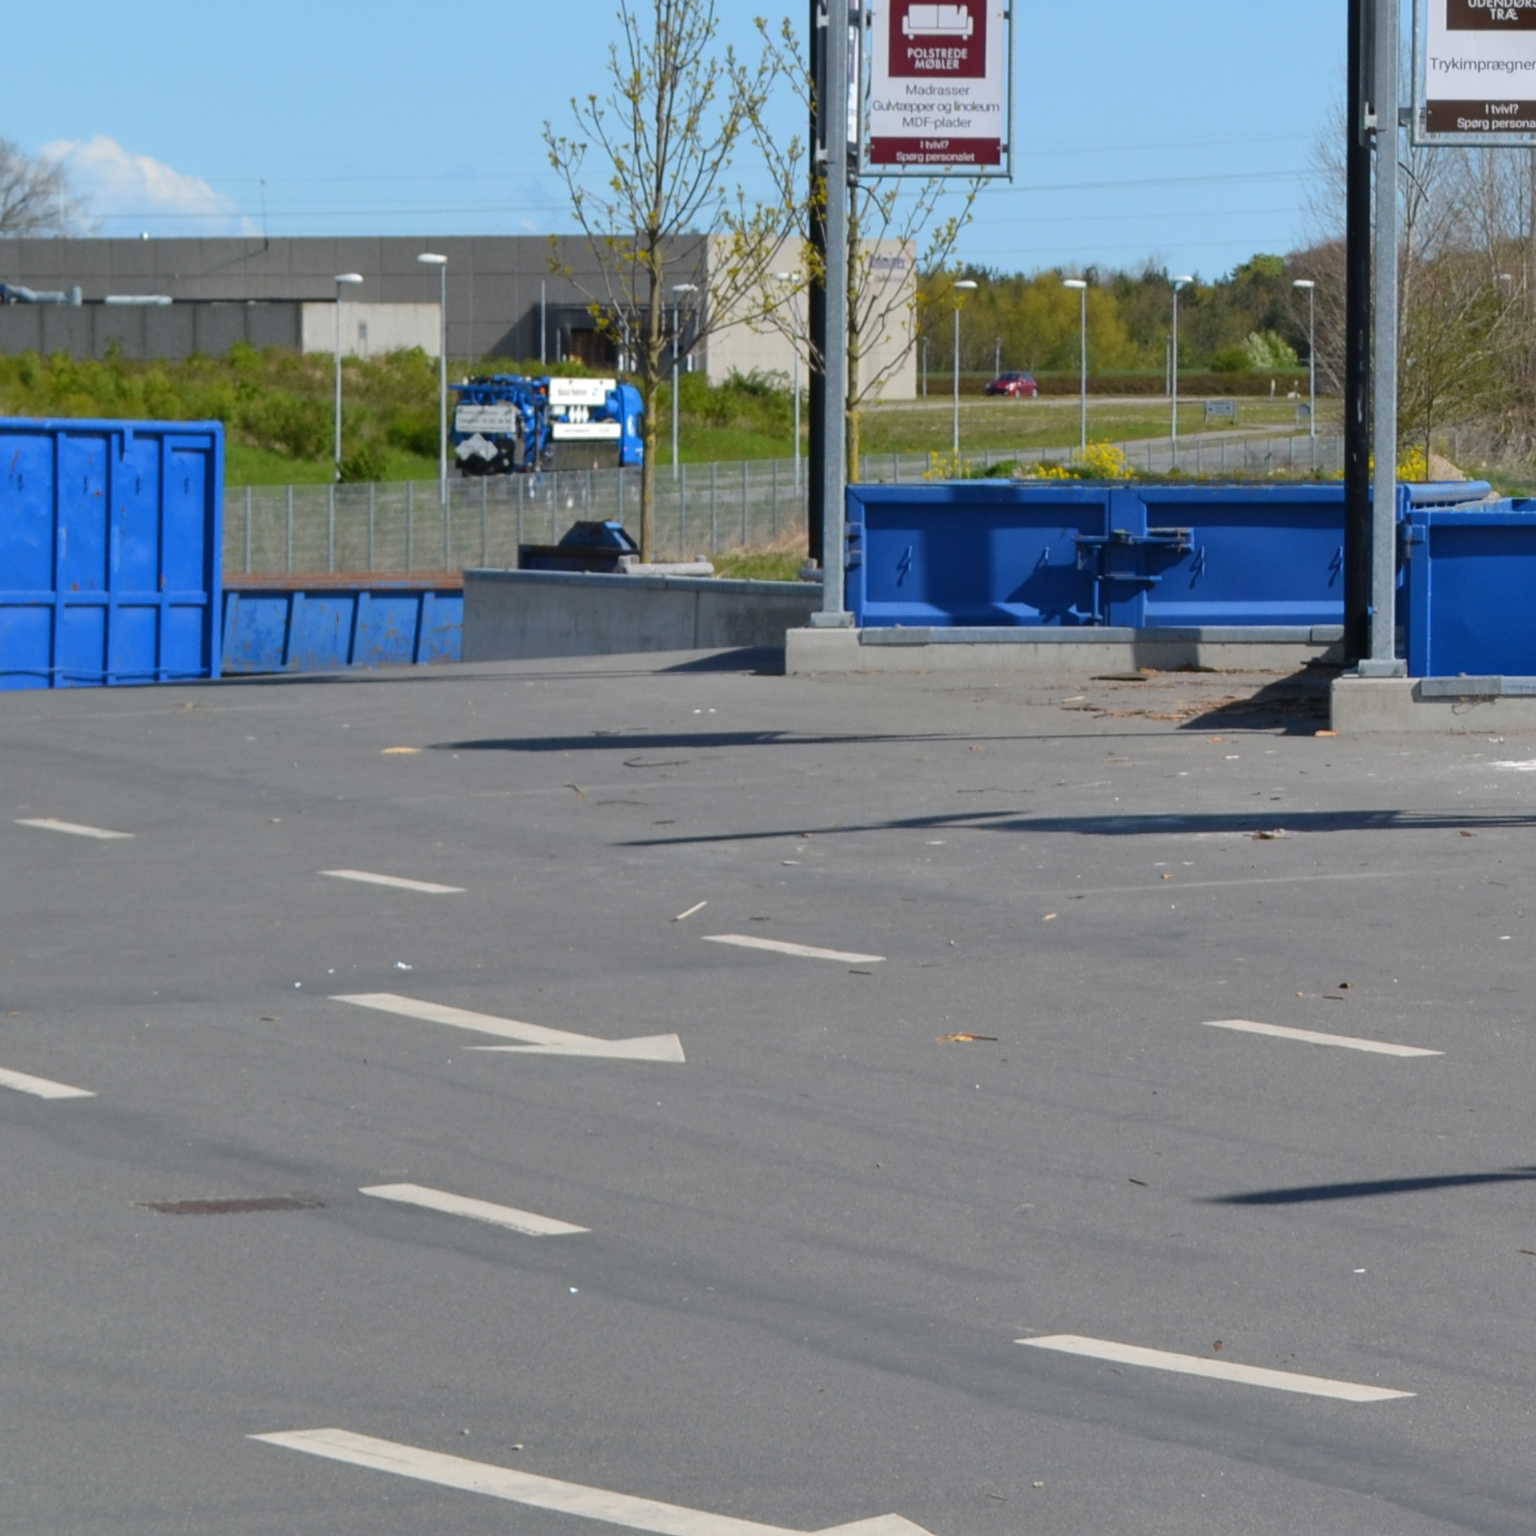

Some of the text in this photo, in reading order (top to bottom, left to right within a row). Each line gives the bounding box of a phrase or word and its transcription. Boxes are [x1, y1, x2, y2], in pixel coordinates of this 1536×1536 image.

[1490, 9, 1518, 21] TRÆ
[908, 48, 968, 59] POLSTREDE
[914, 58, 960, 70] MØBLER
[906, 84, 970, 96] Madrasser
[938, 102, 952, 114] og
[954, 100, 999, 112] linoleum
[1491, 105, 1518, 115] tvivl?
[903, 117, 972, 130] MDF-plader
[1457, 117, 1489, 130] Spørg
